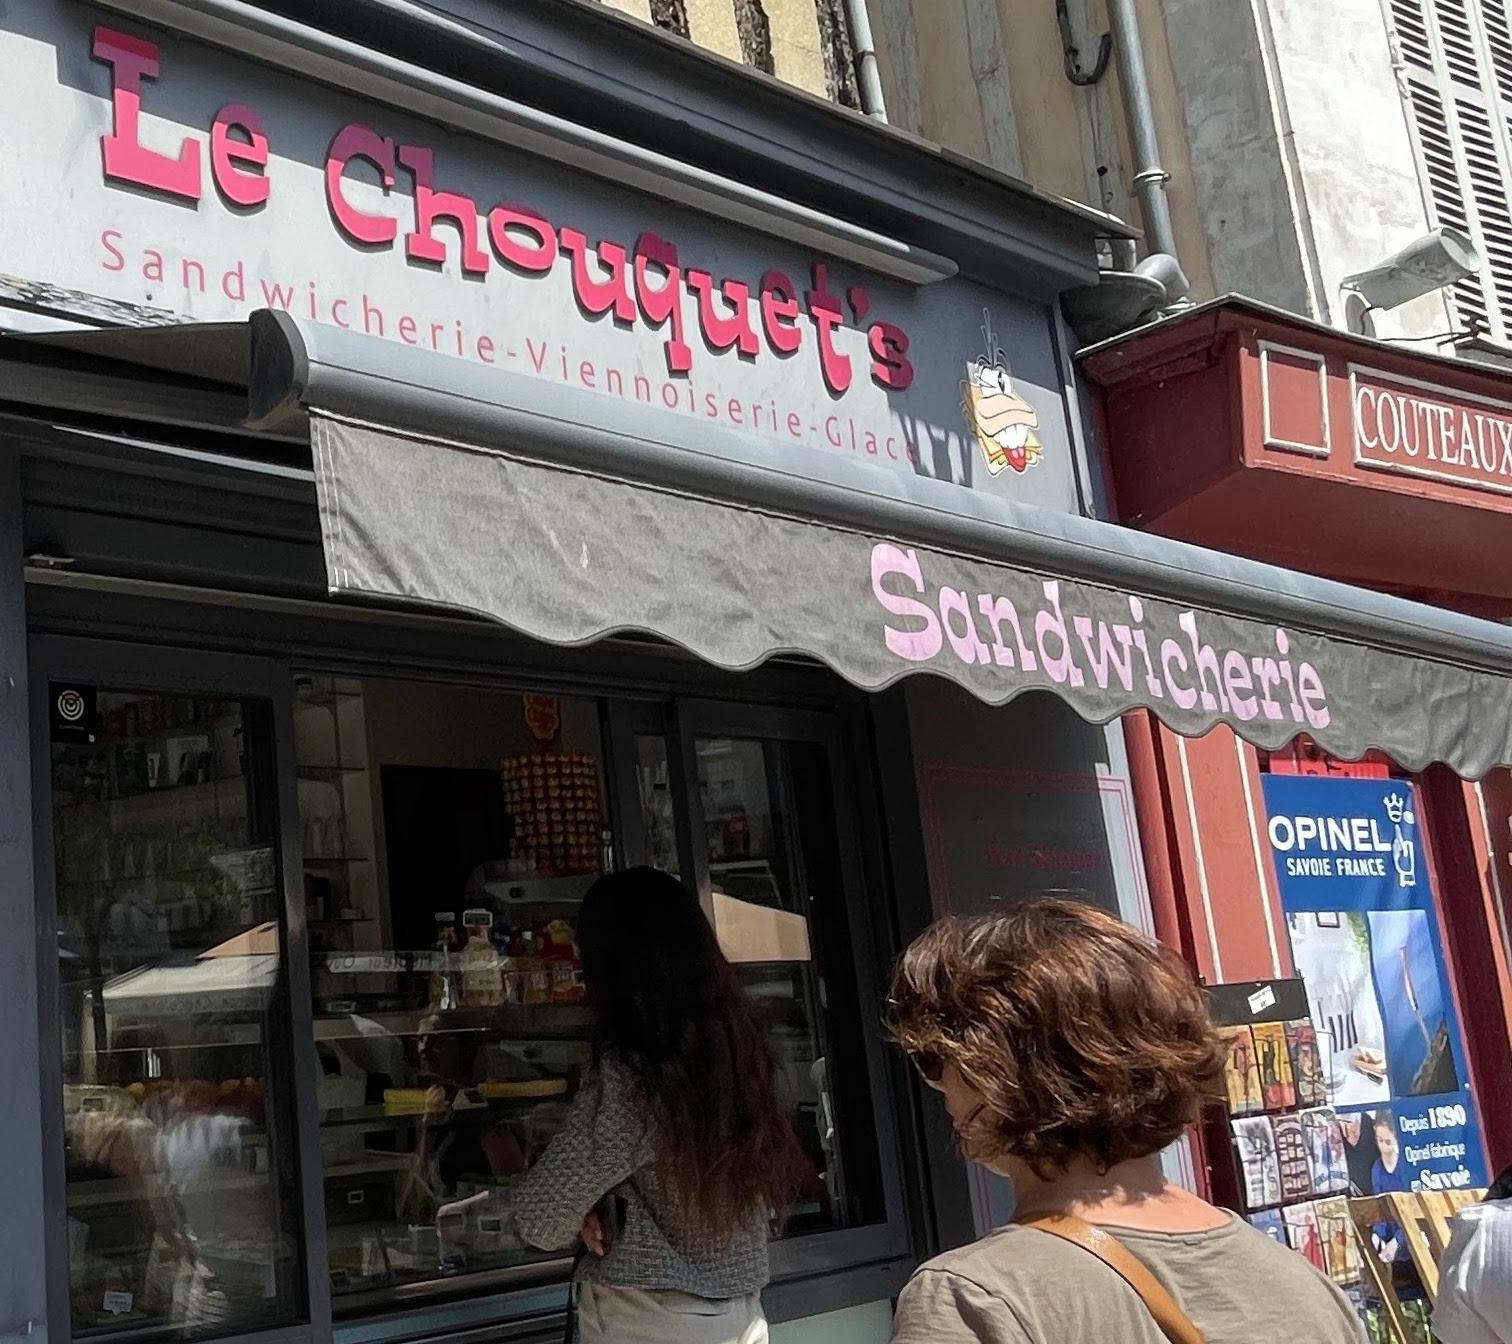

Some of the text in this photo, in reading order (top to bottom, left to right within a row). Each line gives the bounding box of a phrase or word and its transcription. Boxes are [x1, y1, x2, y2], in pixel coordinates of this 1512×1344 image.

[93, 25, 913, 394] Le Chouquet's
[870, 542, 1331, 729] Sandwicherie
[1268, 815, 1391, 852] OPINEL
[1286, 857, 1386, 877] SAVOIE FRANCE
[1399, 1104, 1466, 1136] Depuis 1890
[1420, 1163, 1470, 1191] Savoie
